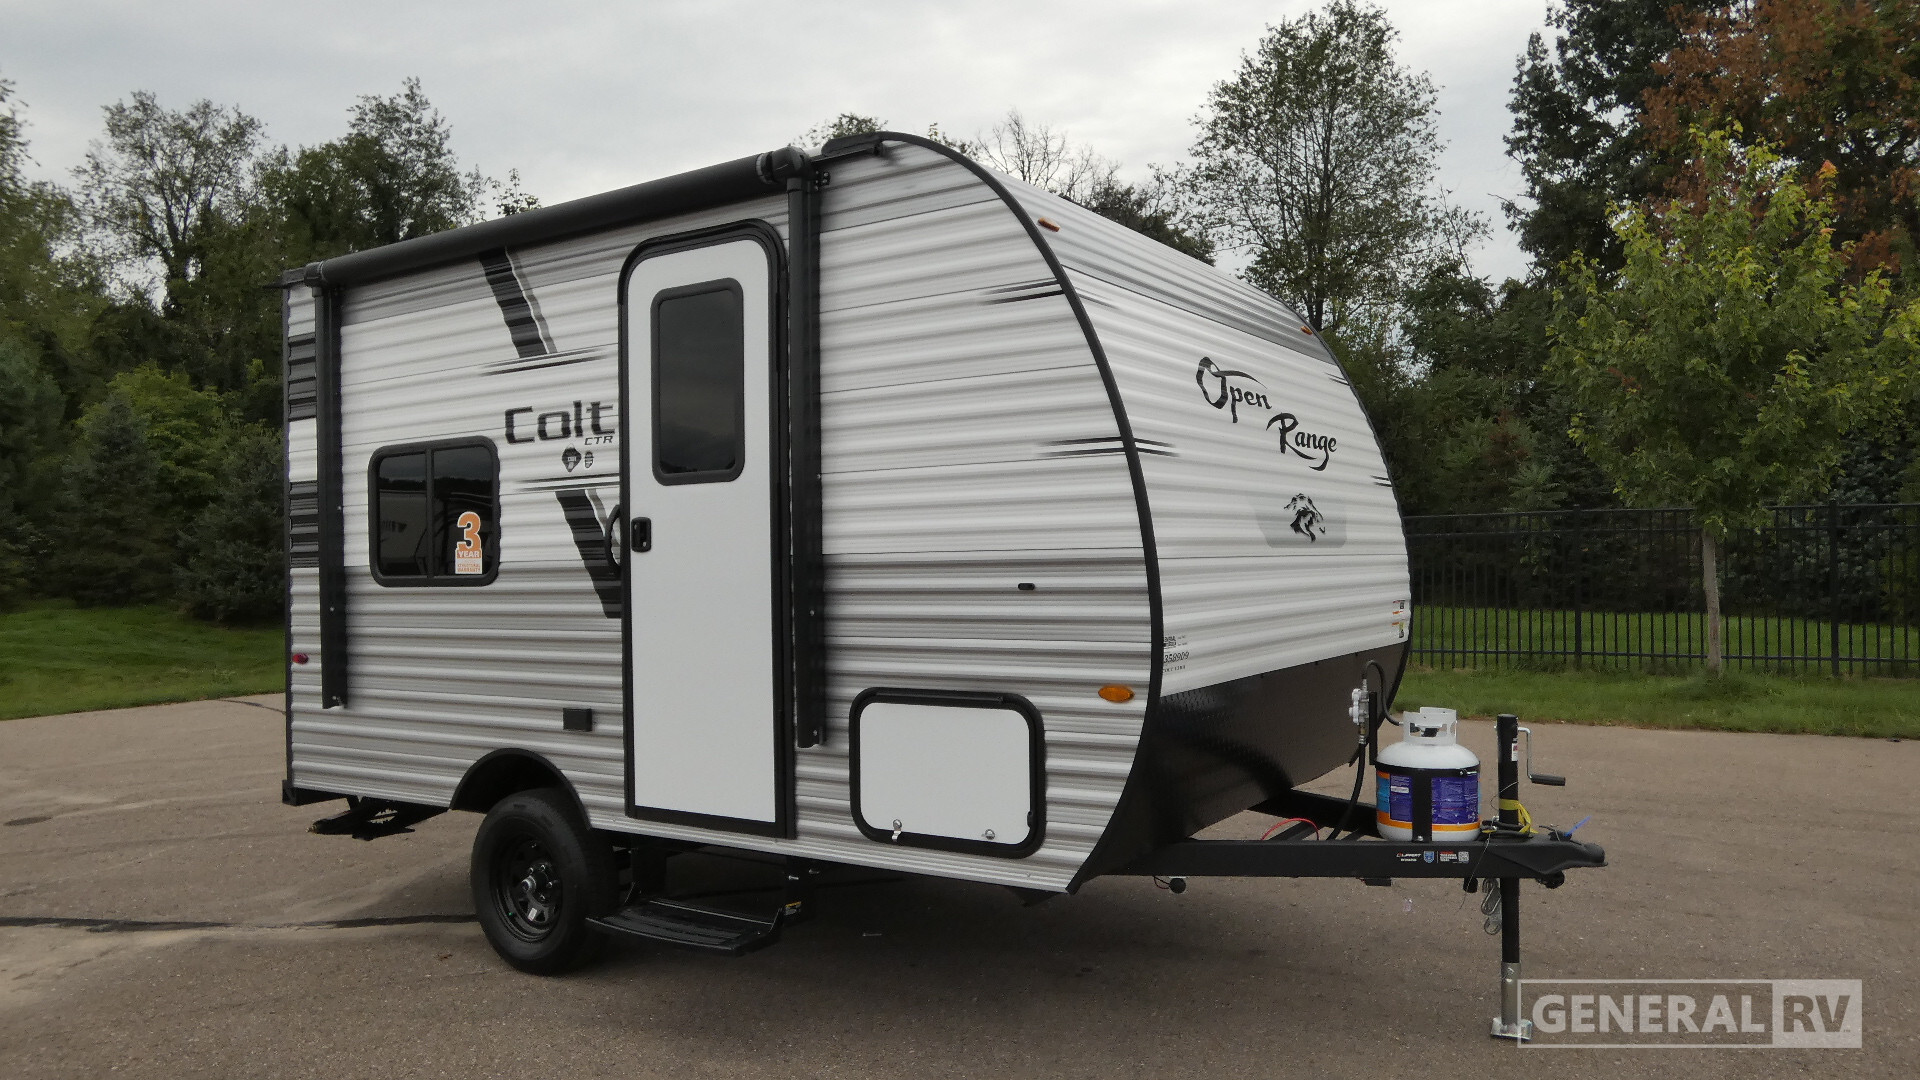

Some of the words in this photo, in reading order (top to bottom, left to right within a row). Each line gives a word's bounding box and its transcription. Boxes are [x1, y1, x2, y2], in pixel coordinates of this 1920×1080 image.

[1196, 357, 1272, 424] Open
[505, 400, 615, 444] Colt
[585, 436, 613, 445] CTR
[1266, 412, 1337, 471] Range
[457, 511, 481, 550] 3
